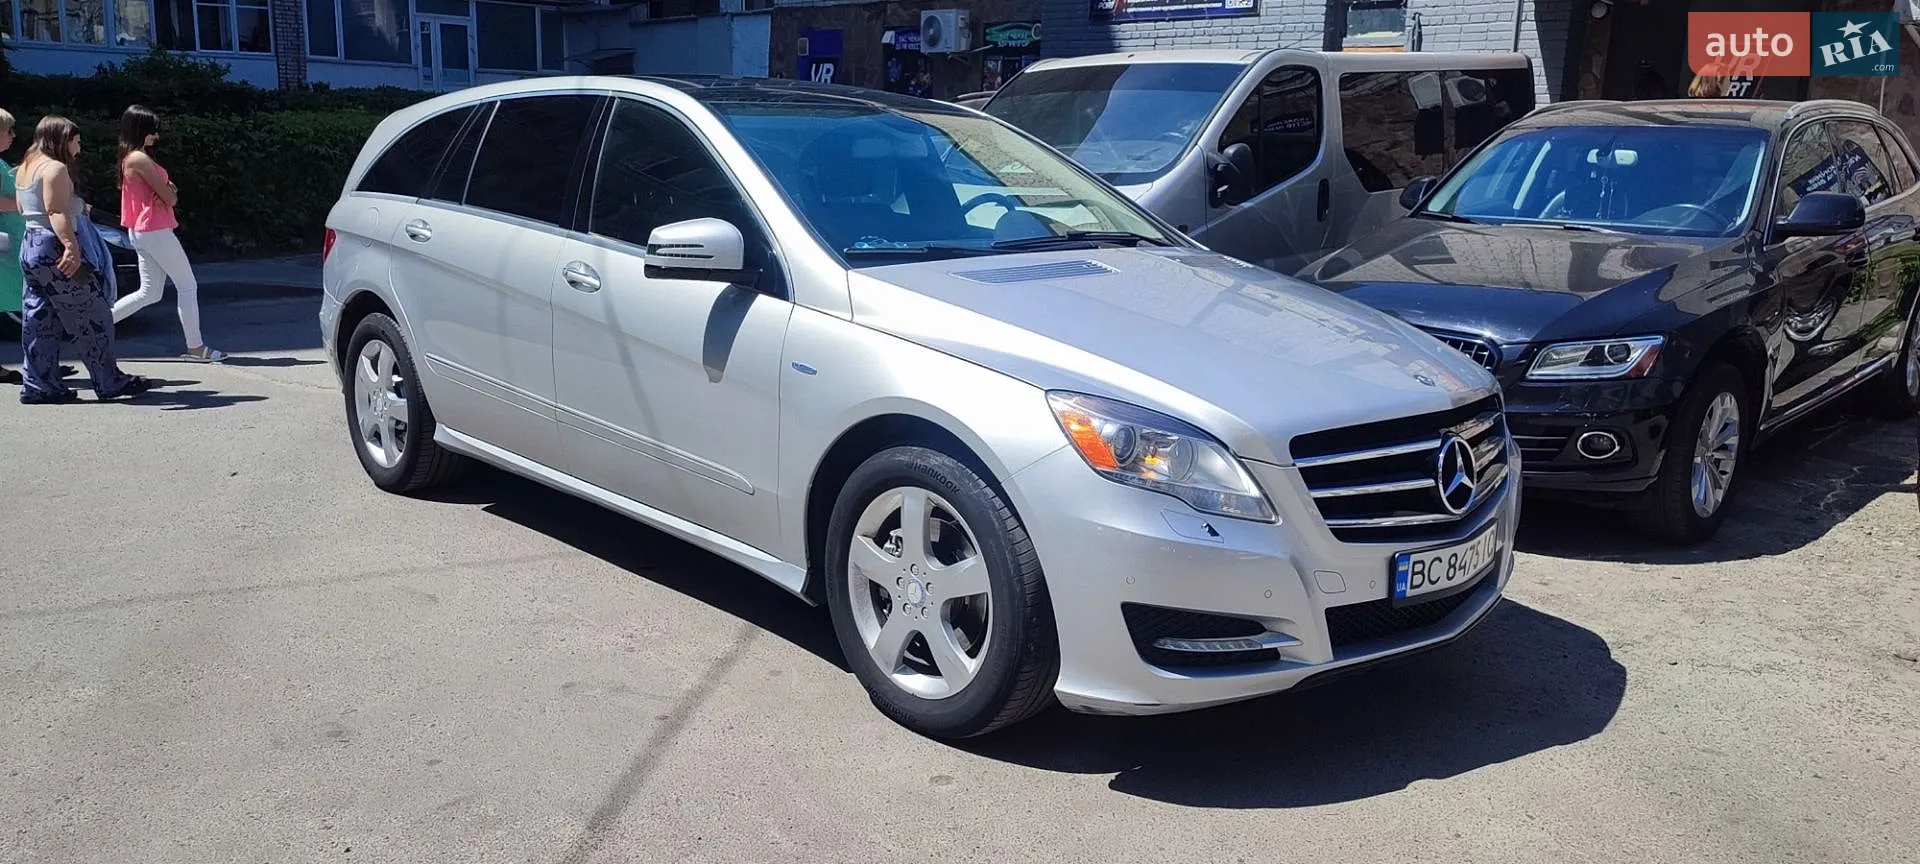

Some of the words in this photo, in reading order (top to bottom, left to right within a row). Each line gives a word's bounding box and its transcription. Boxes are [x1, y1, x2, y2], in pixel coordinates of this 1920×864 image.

[811, 63, 835, 84] VR
[1409, 557, 1443, 590] BC
[1446, 540, 1481, 581] 8475
[1396, 583, 1406, 592] UA
